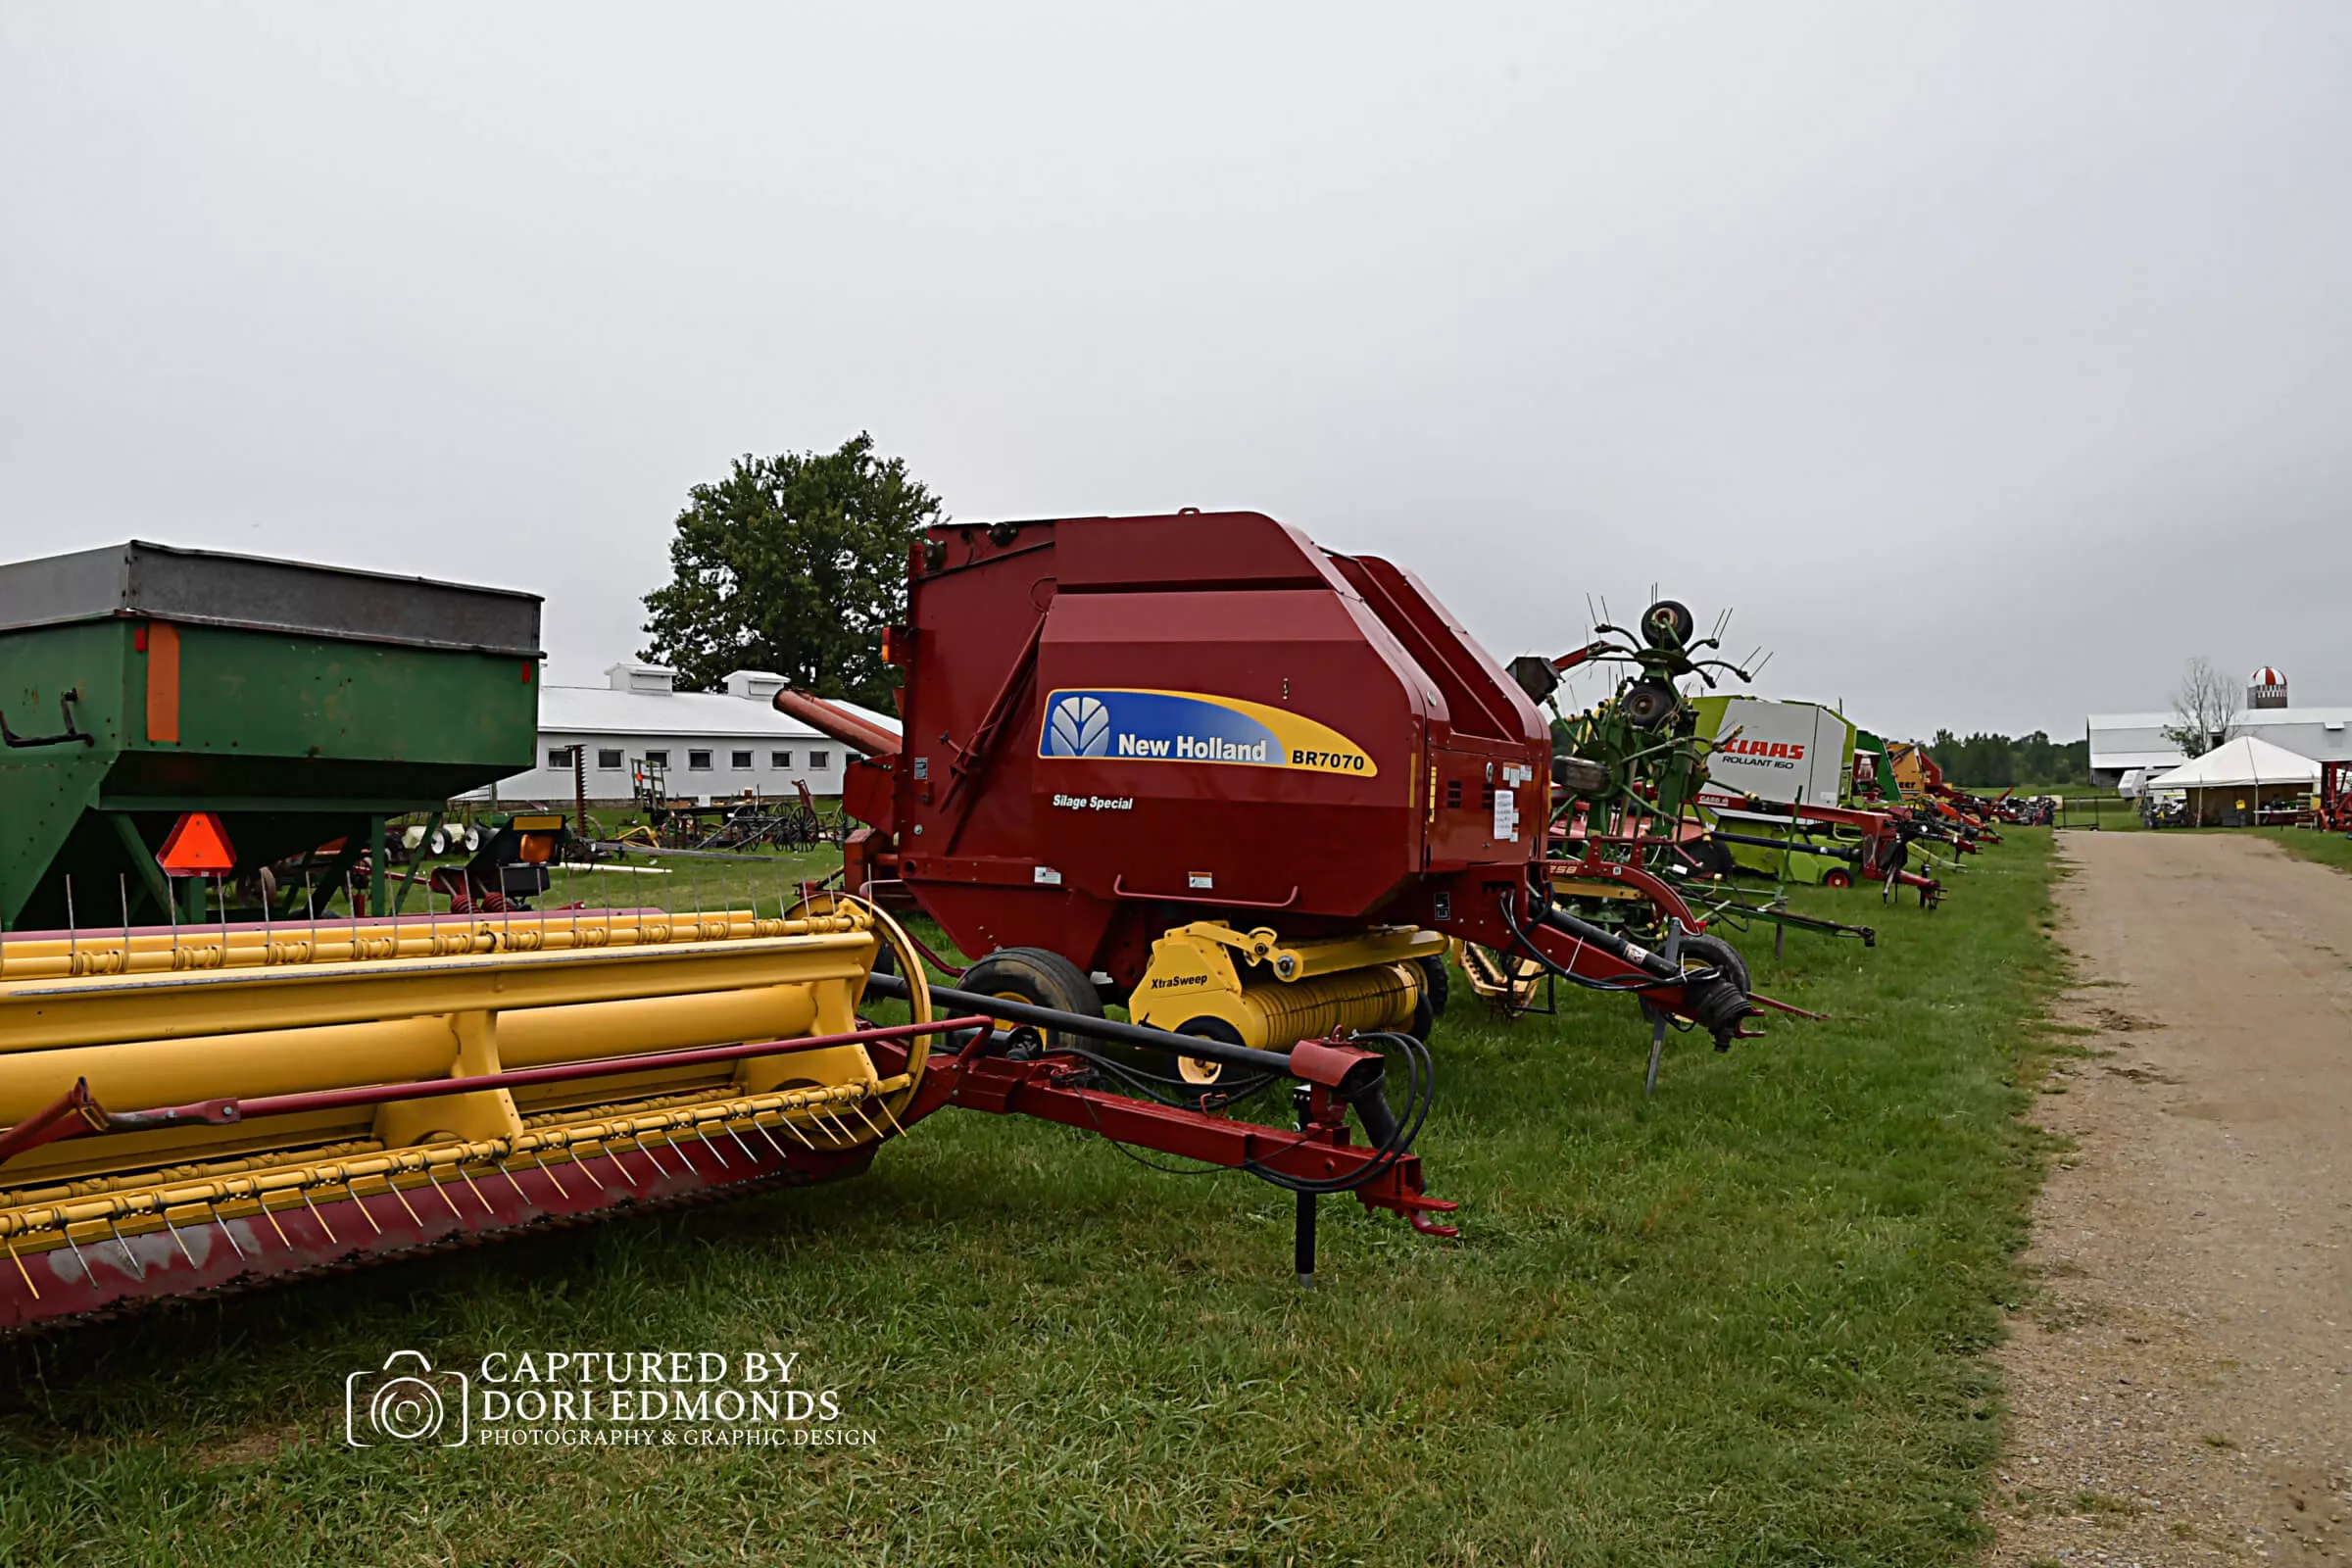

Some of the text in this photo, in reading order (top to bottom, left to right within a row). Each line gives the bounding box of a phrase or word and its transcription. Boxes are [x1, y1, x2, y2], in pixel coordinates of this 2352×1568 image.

[1118, 734, 1267, 762] New Holland
[1725, 738, 1805, 760] CLAAS
[1292, 750, 1364, 771] BR7070
[1722, 756, 1773, 767] ROLLANT
[1053, 794, 1133, 810] Silage Special
[1151, 974, 1207, 990] XtraSweep
